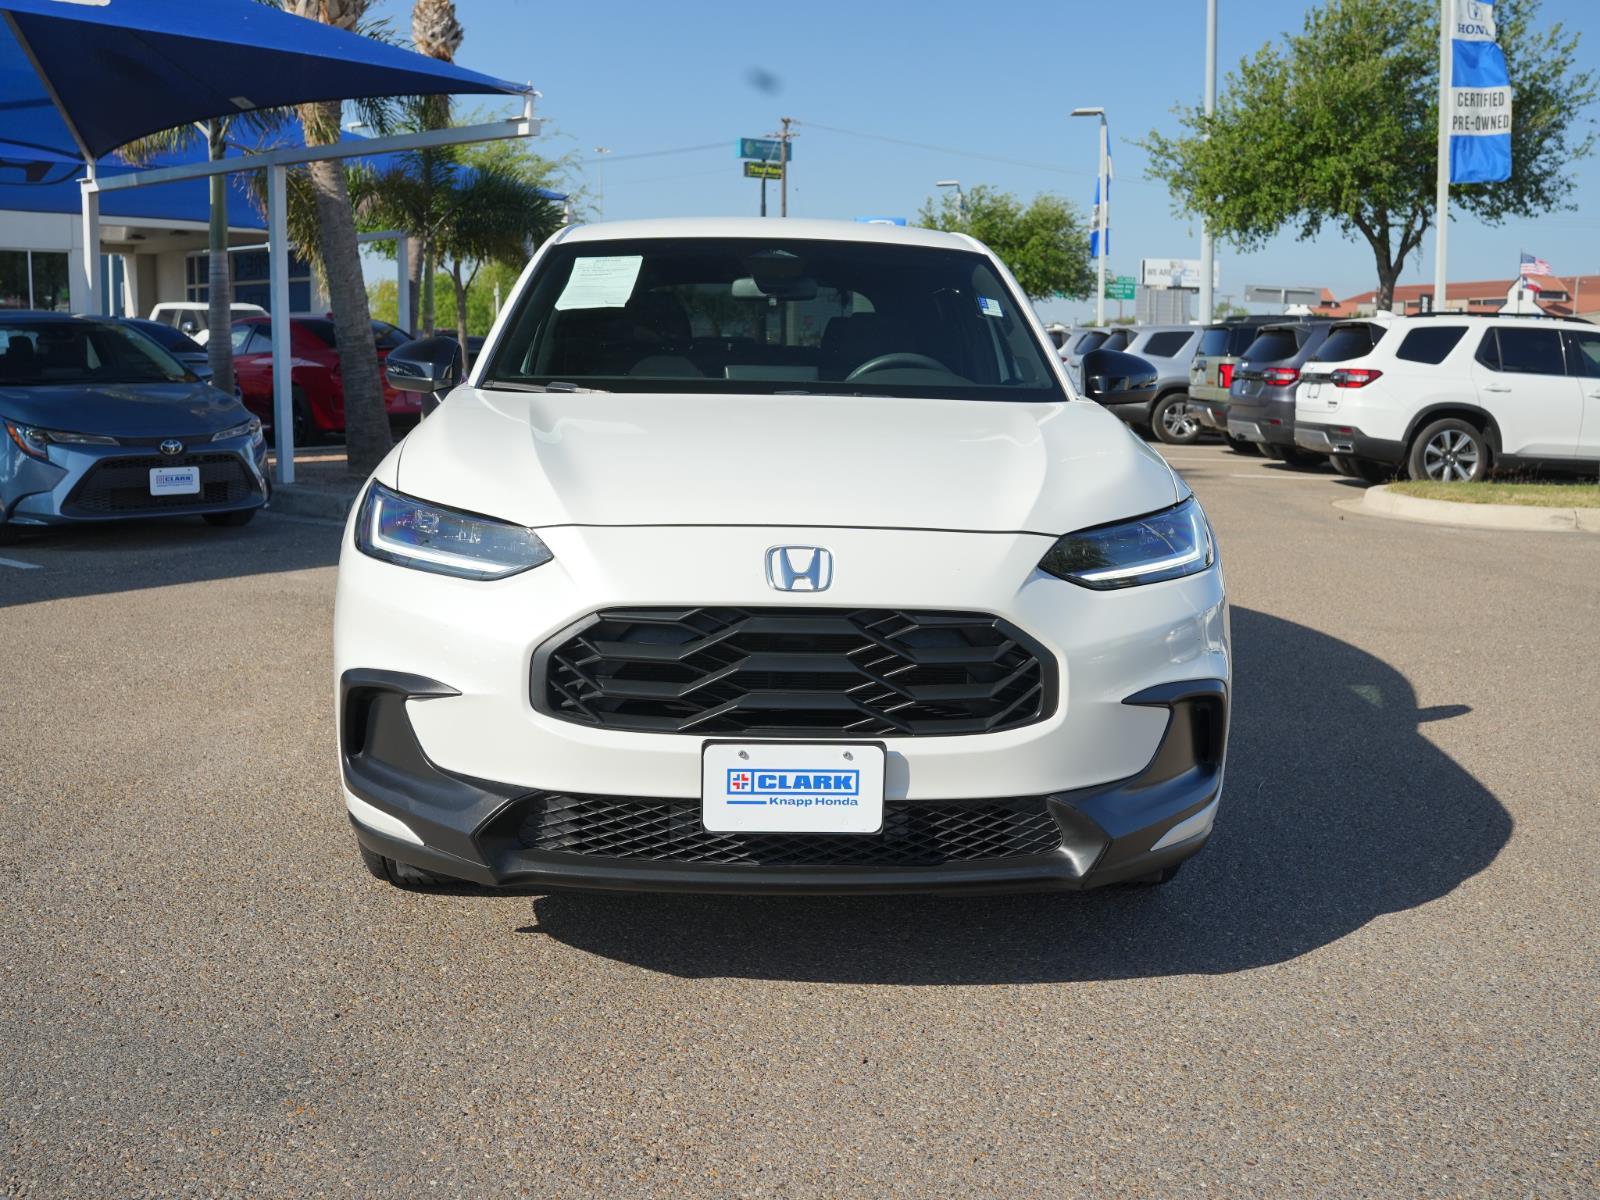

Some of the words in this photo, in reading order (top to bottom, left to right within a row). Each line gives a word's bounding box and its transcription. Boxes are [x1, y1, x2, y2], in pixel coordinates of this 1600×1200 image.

[1457, 92, 1505, 107] CERTIFIED
[1452, 115, 1509, 131] PRE-OWNED
[757, 774, 853, 790] CLARK
[769, 797, 813, 807] Knapp
[815, 797, 858, 806] Honda
